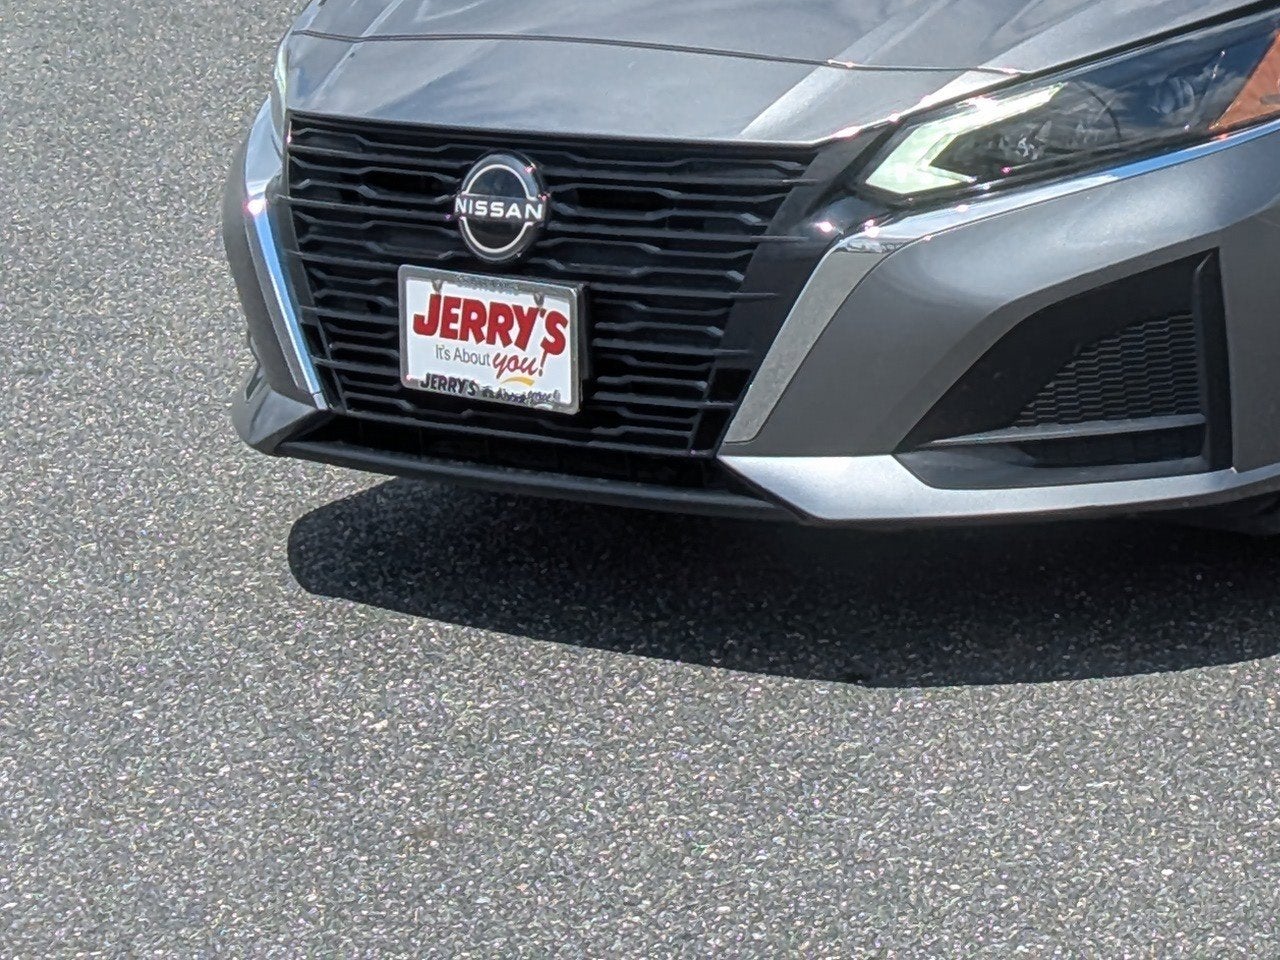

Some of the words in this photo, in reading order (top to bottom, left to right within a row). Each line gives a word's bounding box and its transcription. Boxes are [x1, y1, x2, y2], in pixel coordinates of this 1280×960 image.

[454, 197, 543, 220] NISSAN
[413, 293, 568, 356] JERRY'S
[435, 344, 451, 361] It's
[453, 349, 491, 367] About
[492, 348, 547, 379] you!
[420, 372, 478, 397] JERRY'S
